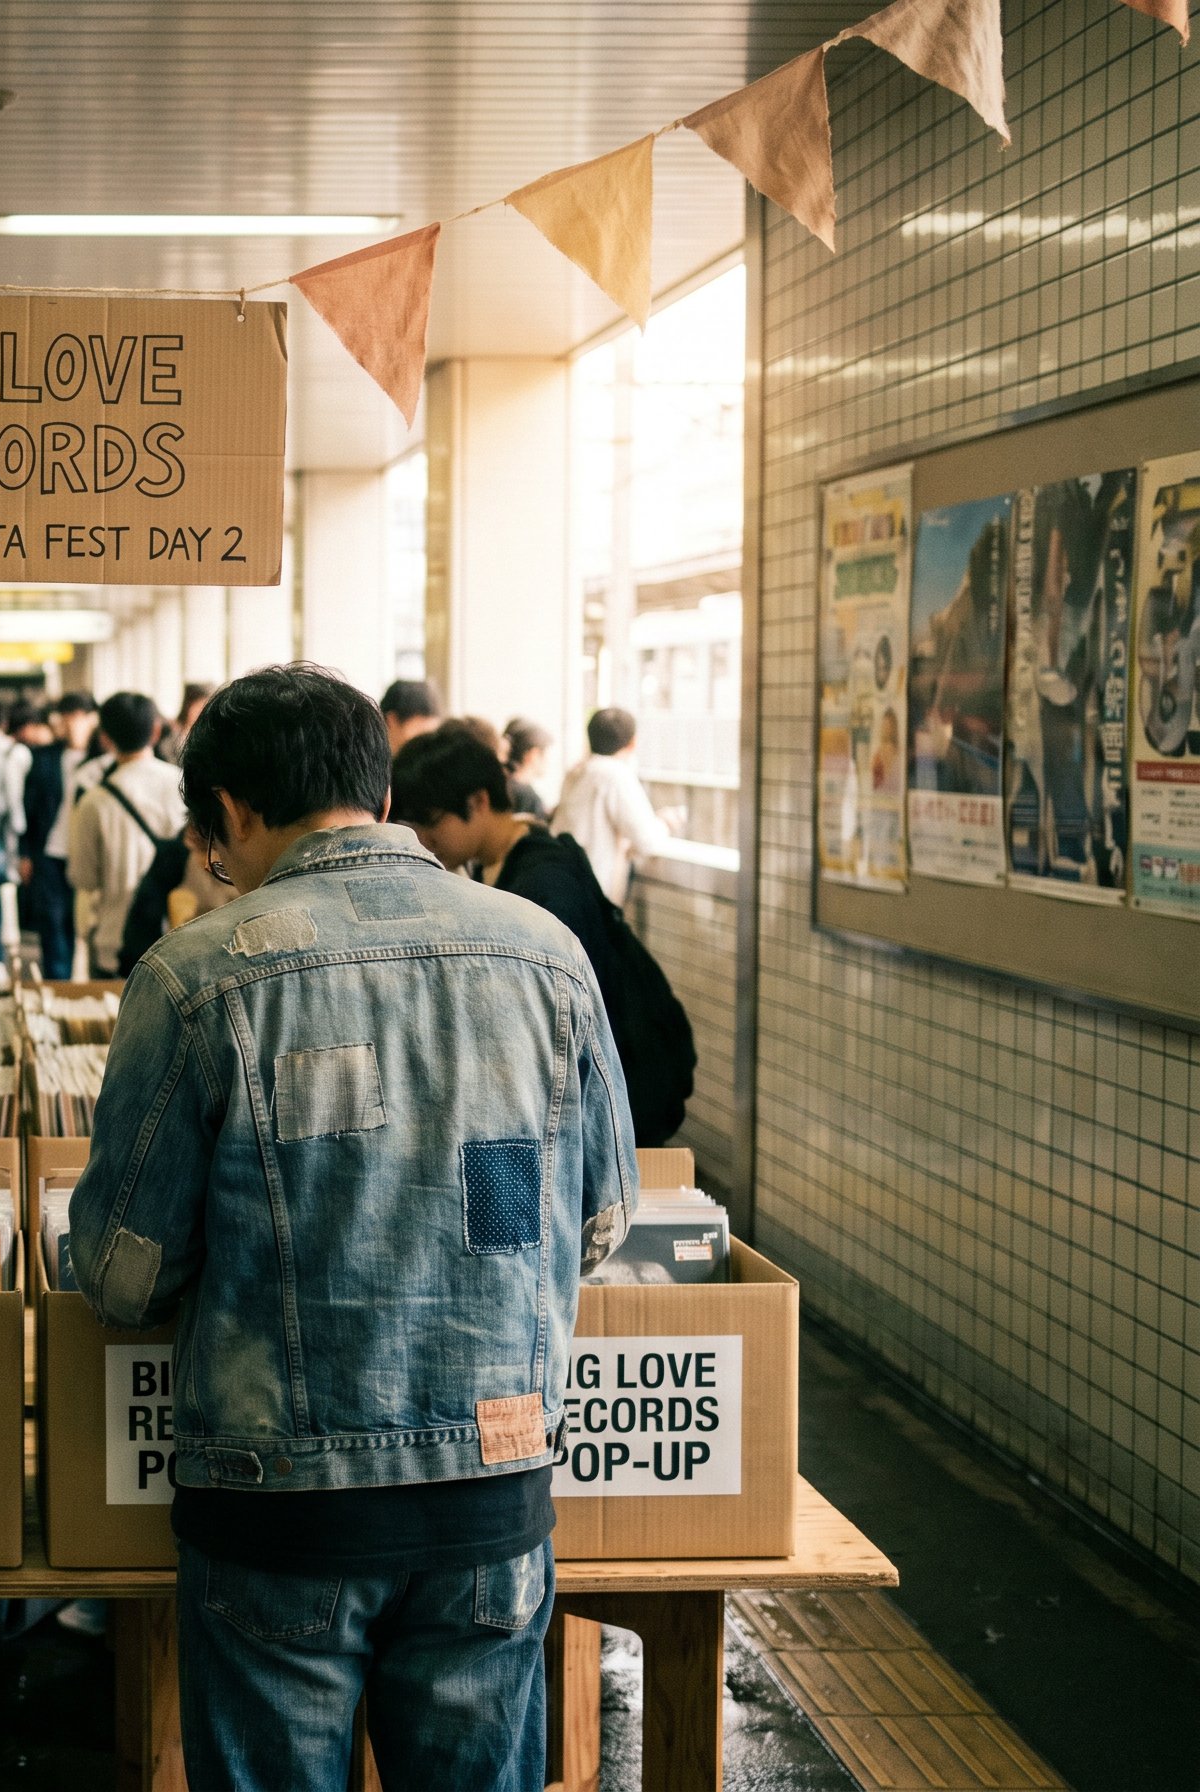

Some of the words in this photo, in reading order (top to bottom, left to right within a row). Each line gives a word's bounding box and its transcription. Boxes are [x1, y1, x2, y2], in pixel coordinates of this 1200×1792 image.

[0, 331, 184, 405] LOVE
[45, 523, 131, 561] FEST
[149, 526, 212, 563] DAY
[220, 526, 247, 563] 2
[616, 1352, 717, 1389] LOVE
[564, 1396, 720, 1434] ECORDS
[552, 1441, 711, 1482] OP-UP
